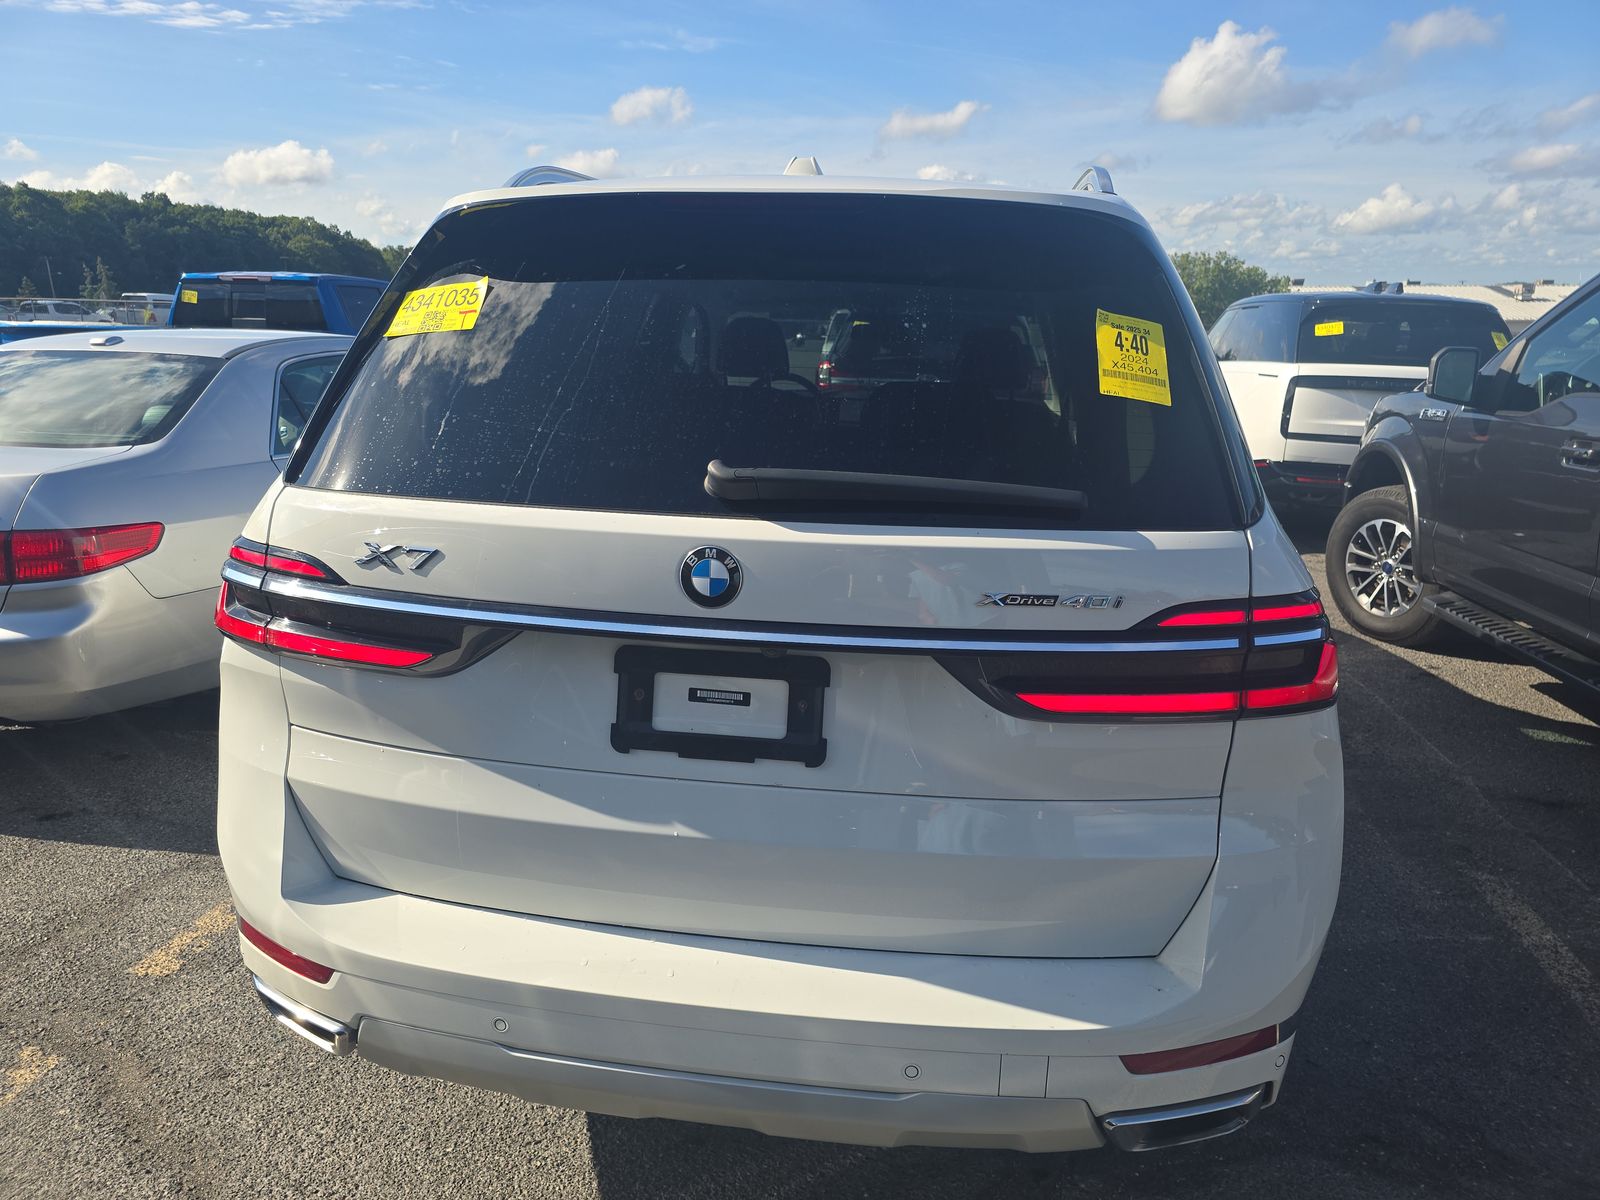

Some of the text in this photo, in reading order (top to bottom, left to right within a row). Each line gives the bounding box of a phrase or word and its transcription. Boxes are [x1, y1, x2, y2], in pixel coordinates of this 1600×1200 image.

[402, 288, 480, 313] 4341035
[1110, 322, 1125, 331] Sale
[1114, 331, 1149, 356] 4:40
[1112, 360, 1159, 376] X45.404
[1120, 353, 1149, 366] 2024
[353, 542, 439, 575] X7
[686, 548, 737, 570] BMW
